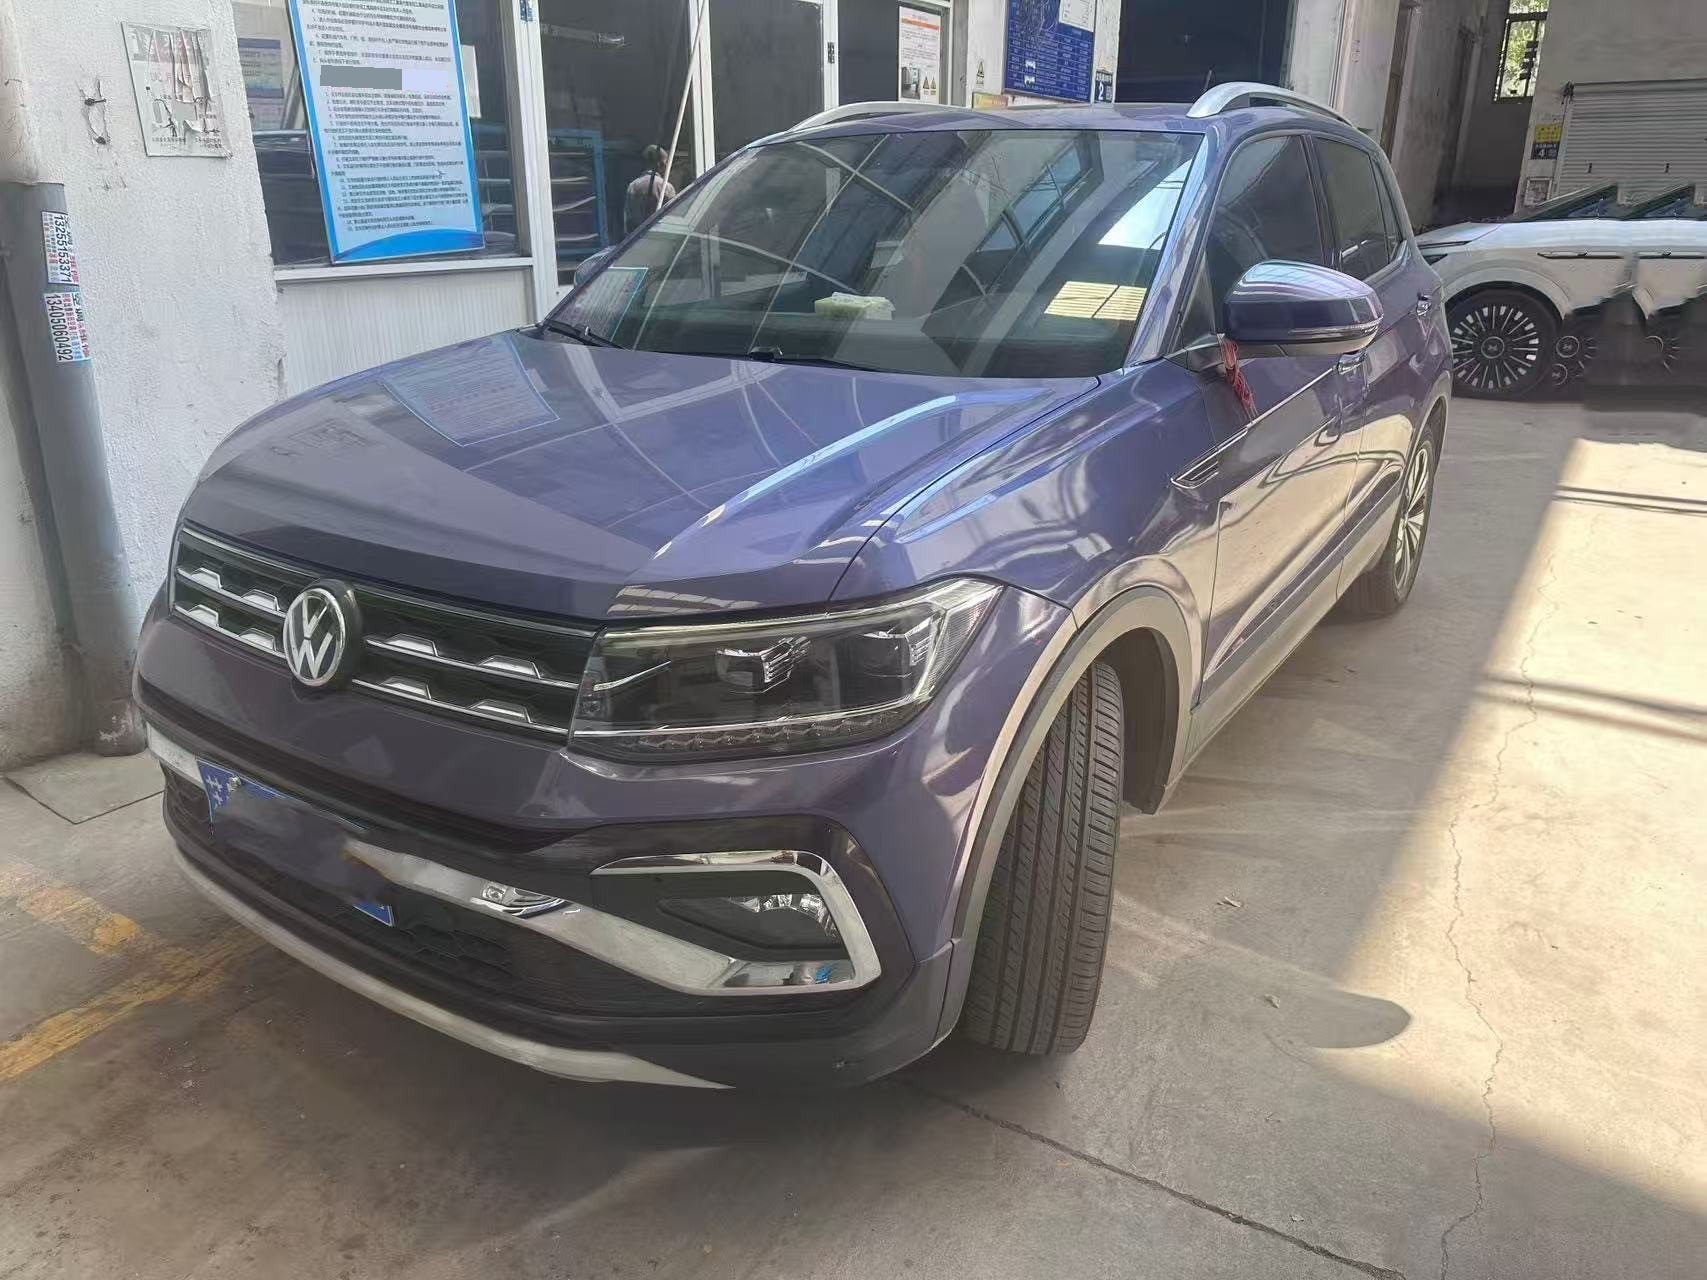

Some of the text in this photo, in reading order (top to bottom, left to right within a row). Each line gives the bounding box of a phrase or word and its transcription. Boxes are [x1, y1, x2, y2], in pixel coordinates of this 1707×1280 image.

[54, 215, 72, 283] 13255153371
[46, 295, 74, 362] 13405060492
[286, 591, 341, 682] VW
